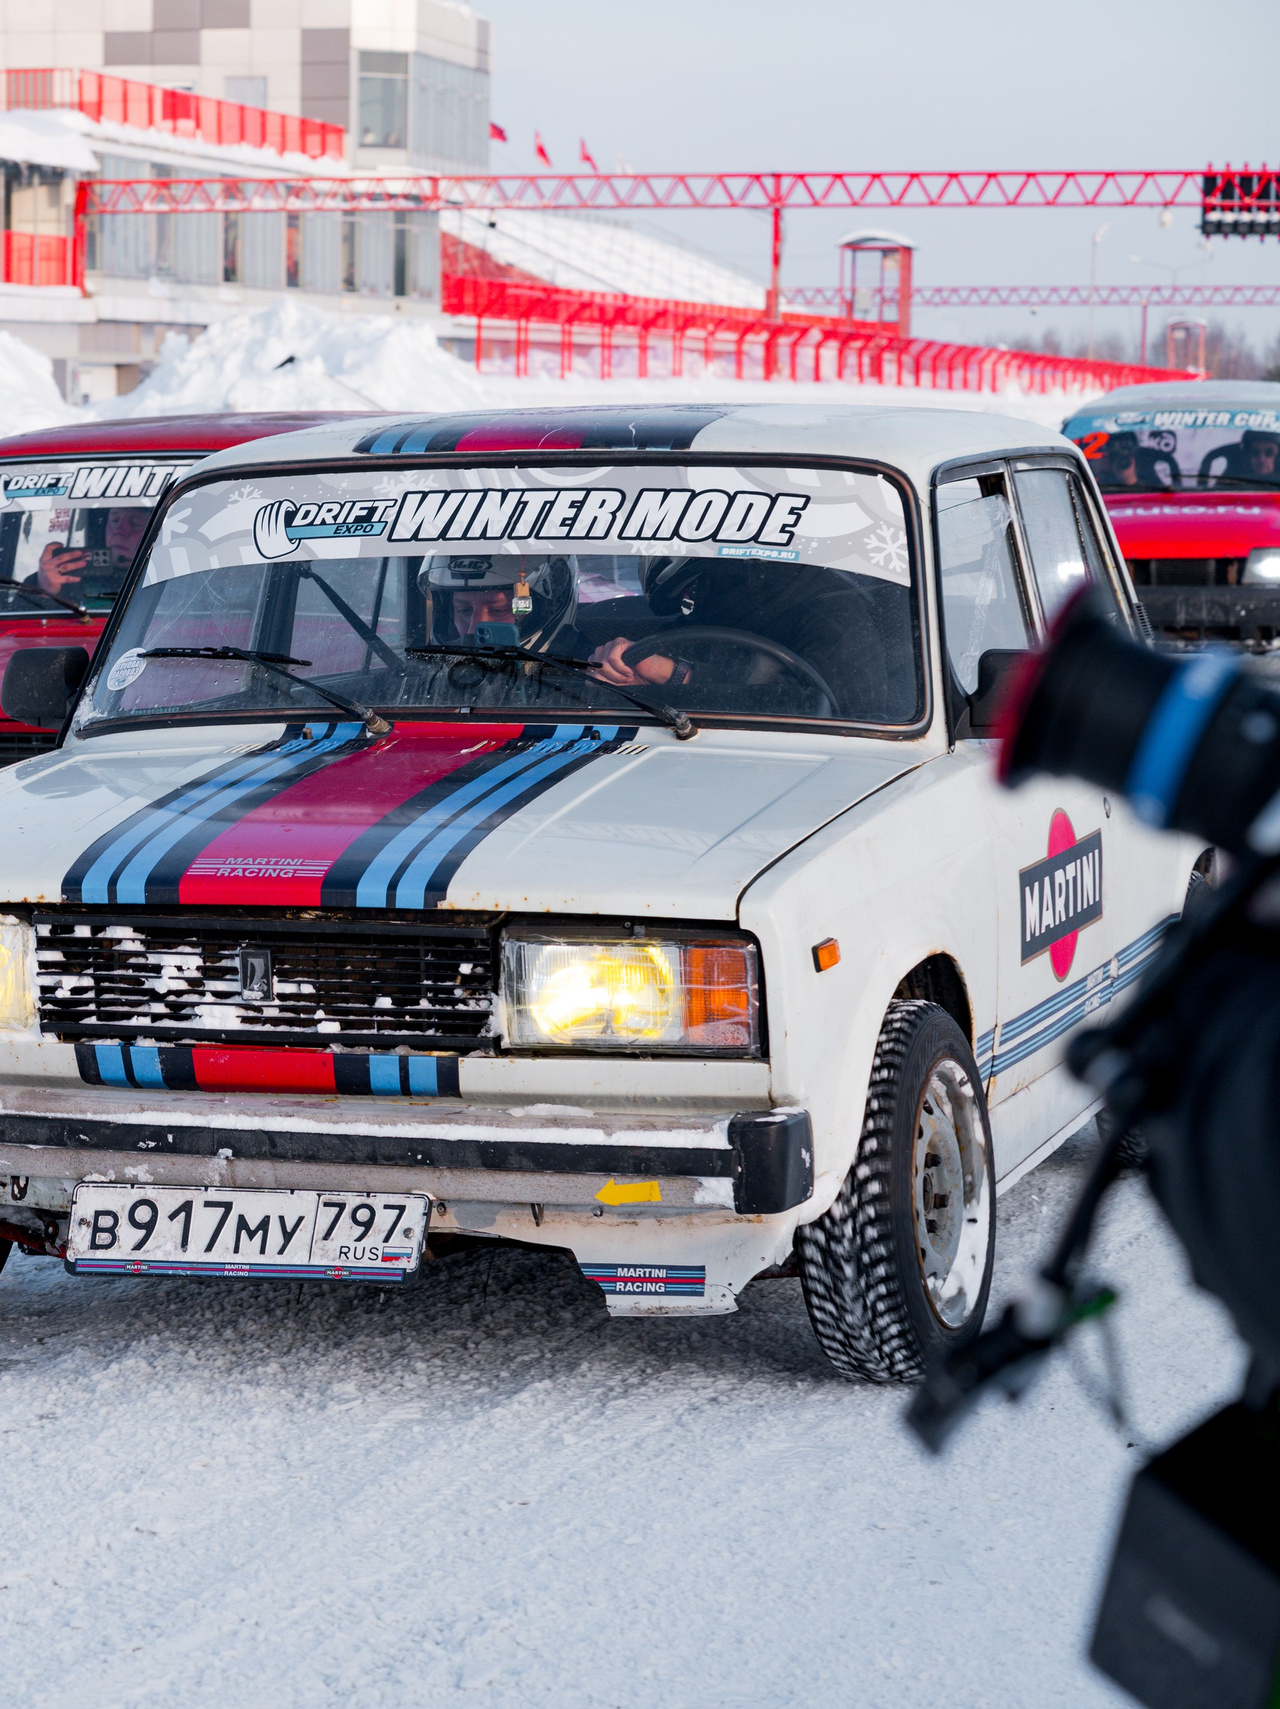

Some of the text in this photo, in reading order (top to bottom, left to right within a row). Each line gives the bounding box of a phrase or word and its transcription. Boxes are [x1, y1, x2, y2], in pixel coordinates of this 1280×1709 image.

[1154, 411, 1232, 427] WINTER
[8, 472, 73, 490] DRIFT
[34, 487, 61, 496] EXPO
[292, 488, 811, 547] DRIFT WINTER MODE
[332, 524, 374, 535] EXPO
[720, 547, 797, 560] DRIFTEXPO.RU
[216, 867, 295, 878] RACING
[1024, 848, 1101, 943] MARTINI
[322, 1200, 408, 1243] 797
[338, 1245, 380, 1262] RUS
[125, 1263, 149, 1271] MARTINI
[224, 1263, 251, 1271] MARTINI
[223, 1270, 250, 1278] RACING
[325, 1269, 350, 1277] MARTINI
[617, 1268, 667, 1278] MARTINI
[616, 1282, 665, 1292] RACING
